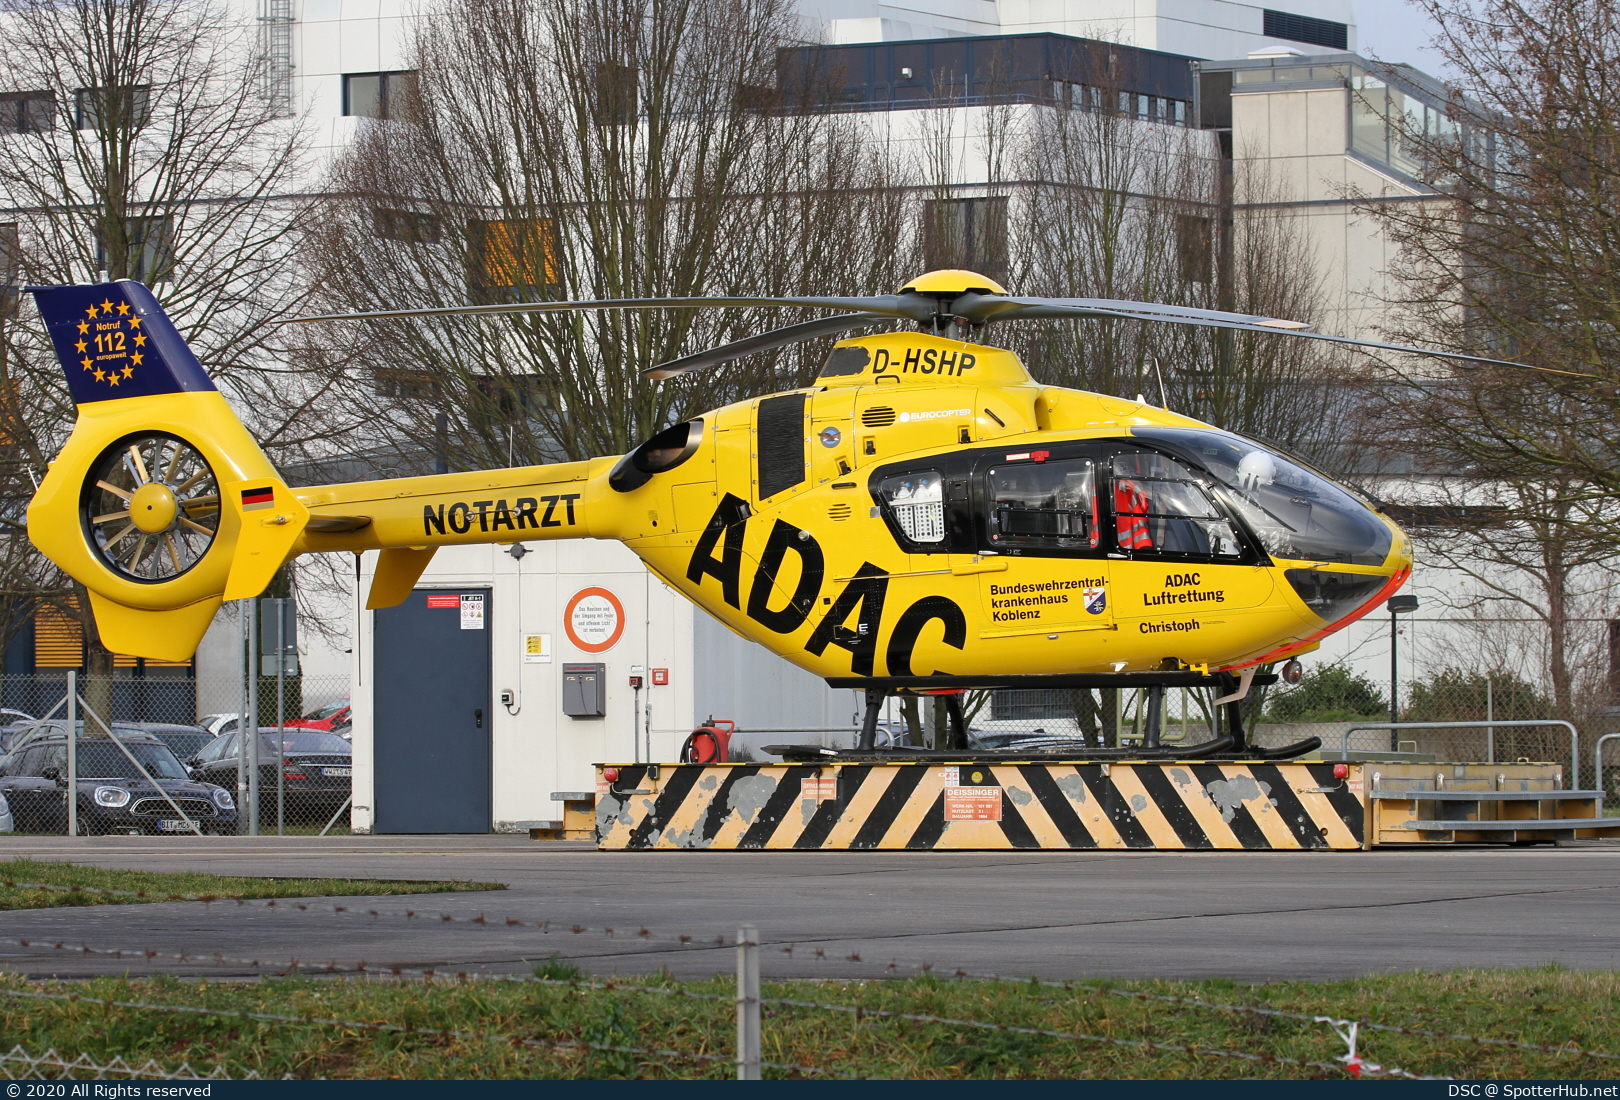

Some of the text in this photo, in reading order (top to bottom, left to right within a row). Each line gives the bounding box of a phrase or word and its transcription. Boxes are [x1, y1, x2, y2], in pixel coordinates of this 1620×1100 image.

[96, 321, 120, 331] Notruf
[94, 331, 126, 353] 112
[96, 352, 127, 361] europaweit
[872, 348, 976, 377] D-HSHP
[911, 408, 971, 420] EUROCOPTER
[424, 493, 581, 536] NOTARZT
[686, 492, 966, 677] ADAC
[990, 576, 1109, 595] Bundeswehrzentral-
[1164, 573, 1201, 588] ADAC
[991, 594, 1068, 609] krankenhaus
[1143, 590, 1225, 607] Luftrettung
[992, 610, 1041, 622] Koblenz
[1139, 618, 1200, 634] Christoph
